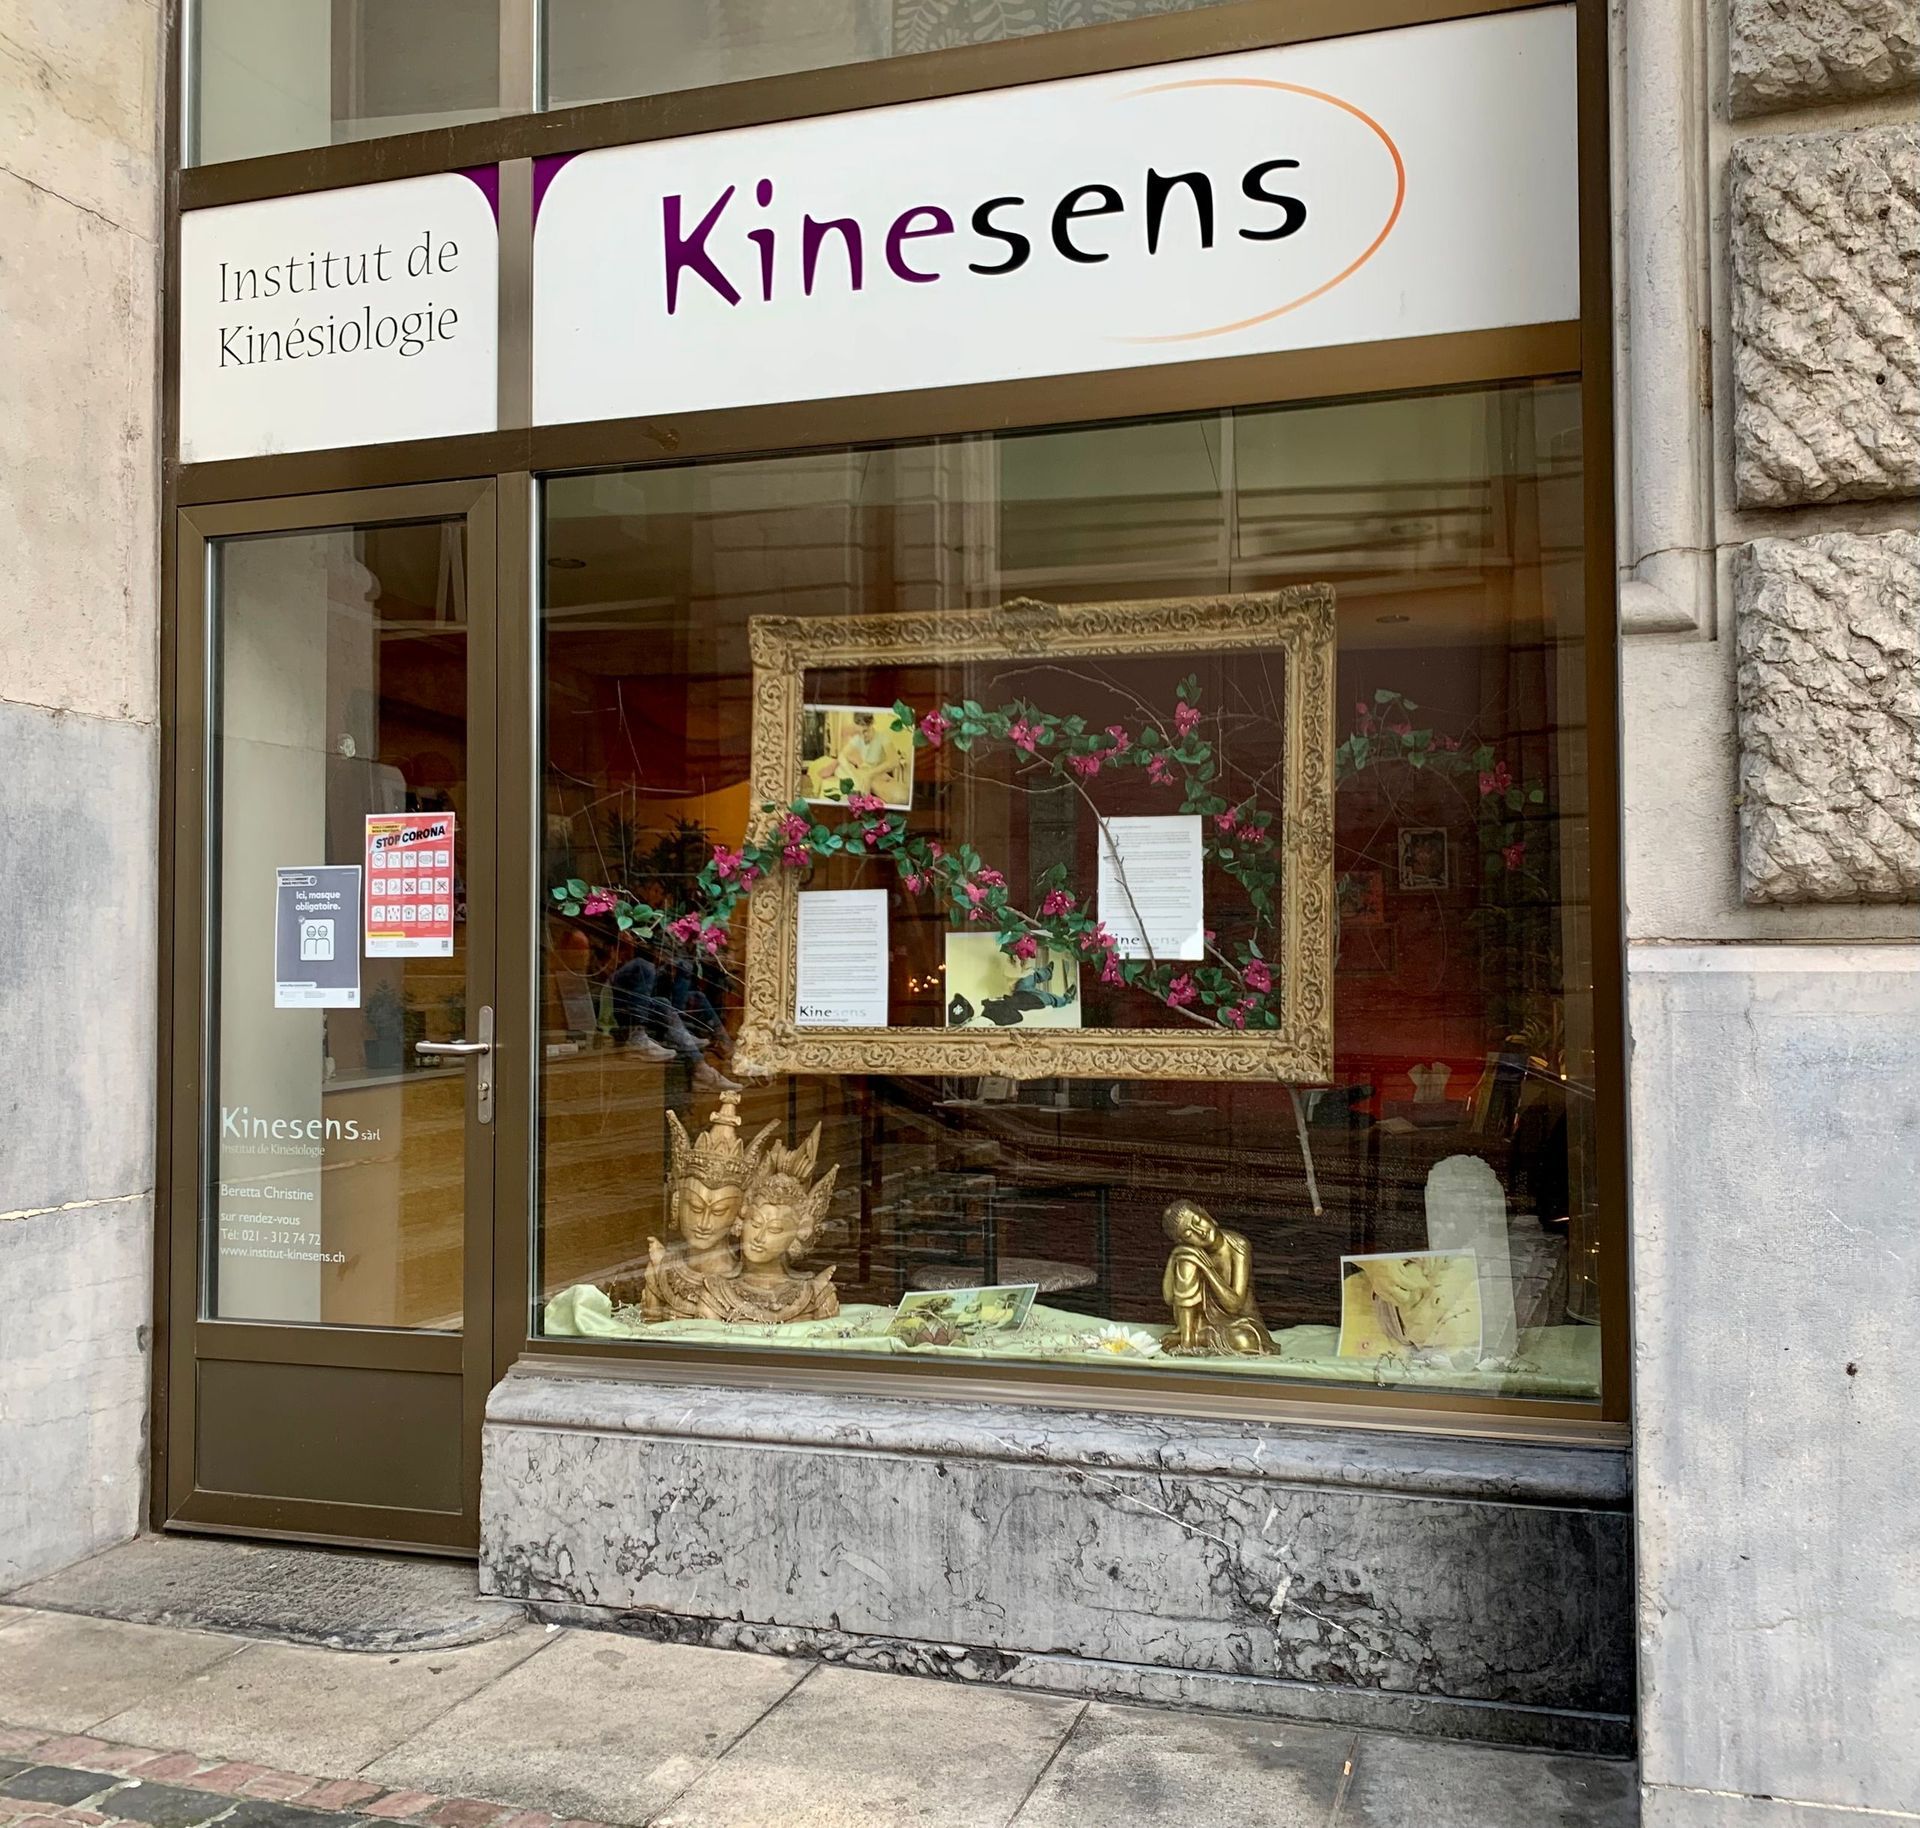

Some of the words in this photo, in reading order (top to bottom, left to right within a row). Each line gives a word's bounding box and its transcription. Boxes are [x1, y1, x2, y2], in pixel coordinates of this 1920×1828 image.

[661, 157, 1308, 315] Kinesens
[218, 243, 392, 304] Institut
[407, 230, 459, 278] de
[218, 302, 459, 368] Kinésiologie
[375, 834, 401, 849] STOP
[402, 825, 446, 843] CORONA
[295, 890, 307, 900] Ici,
[308, 891, 341, 901] masque
[295, 901, 341, 913] obligatoire.
[221, 1106, 359, 1141] Kinesens
[222, 1143, 256, 1154] Institut
[257, 1143, 269, 1154] de
[220, 1183, 261, 1198] Beretta
[263, 1185, 314, 1201] Christine
[220, 1212, 237, 1222] sur
[238, 1211, 301, 1226] rendez-vous
[242, 1230, 260, 1242] 021
[271, 1231, 290, 1244] 312
[293, 1232, 305, 1245] 74
[308, 1233, 321, 1246] 72
[220, 1246, 346, 1263] www.institut-kinesens.ch
